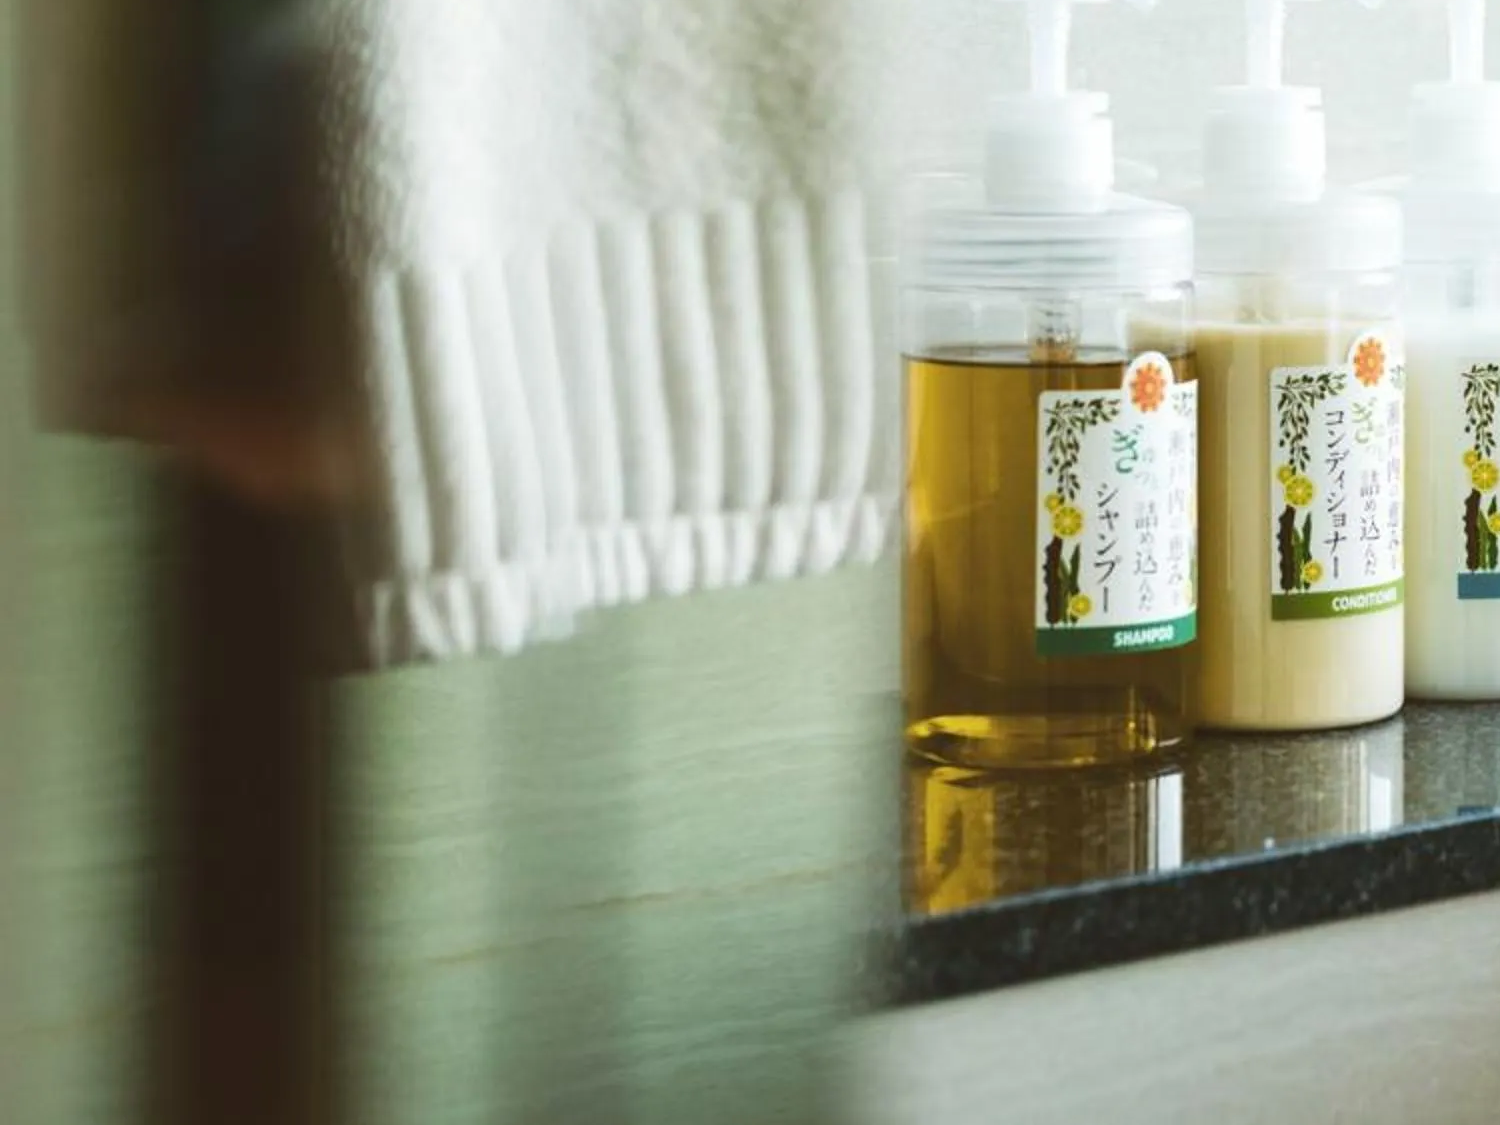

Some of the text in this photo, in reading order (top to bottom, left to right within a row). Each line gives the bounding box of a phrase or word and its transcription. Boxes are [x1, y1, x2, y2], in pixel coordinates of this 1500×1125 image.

[1093, 482, 1122, 613] シャンプー
[1322, 409, 1350, 580] コンディショナー
[1112, 624, 1175, 648] SHAMPOO
